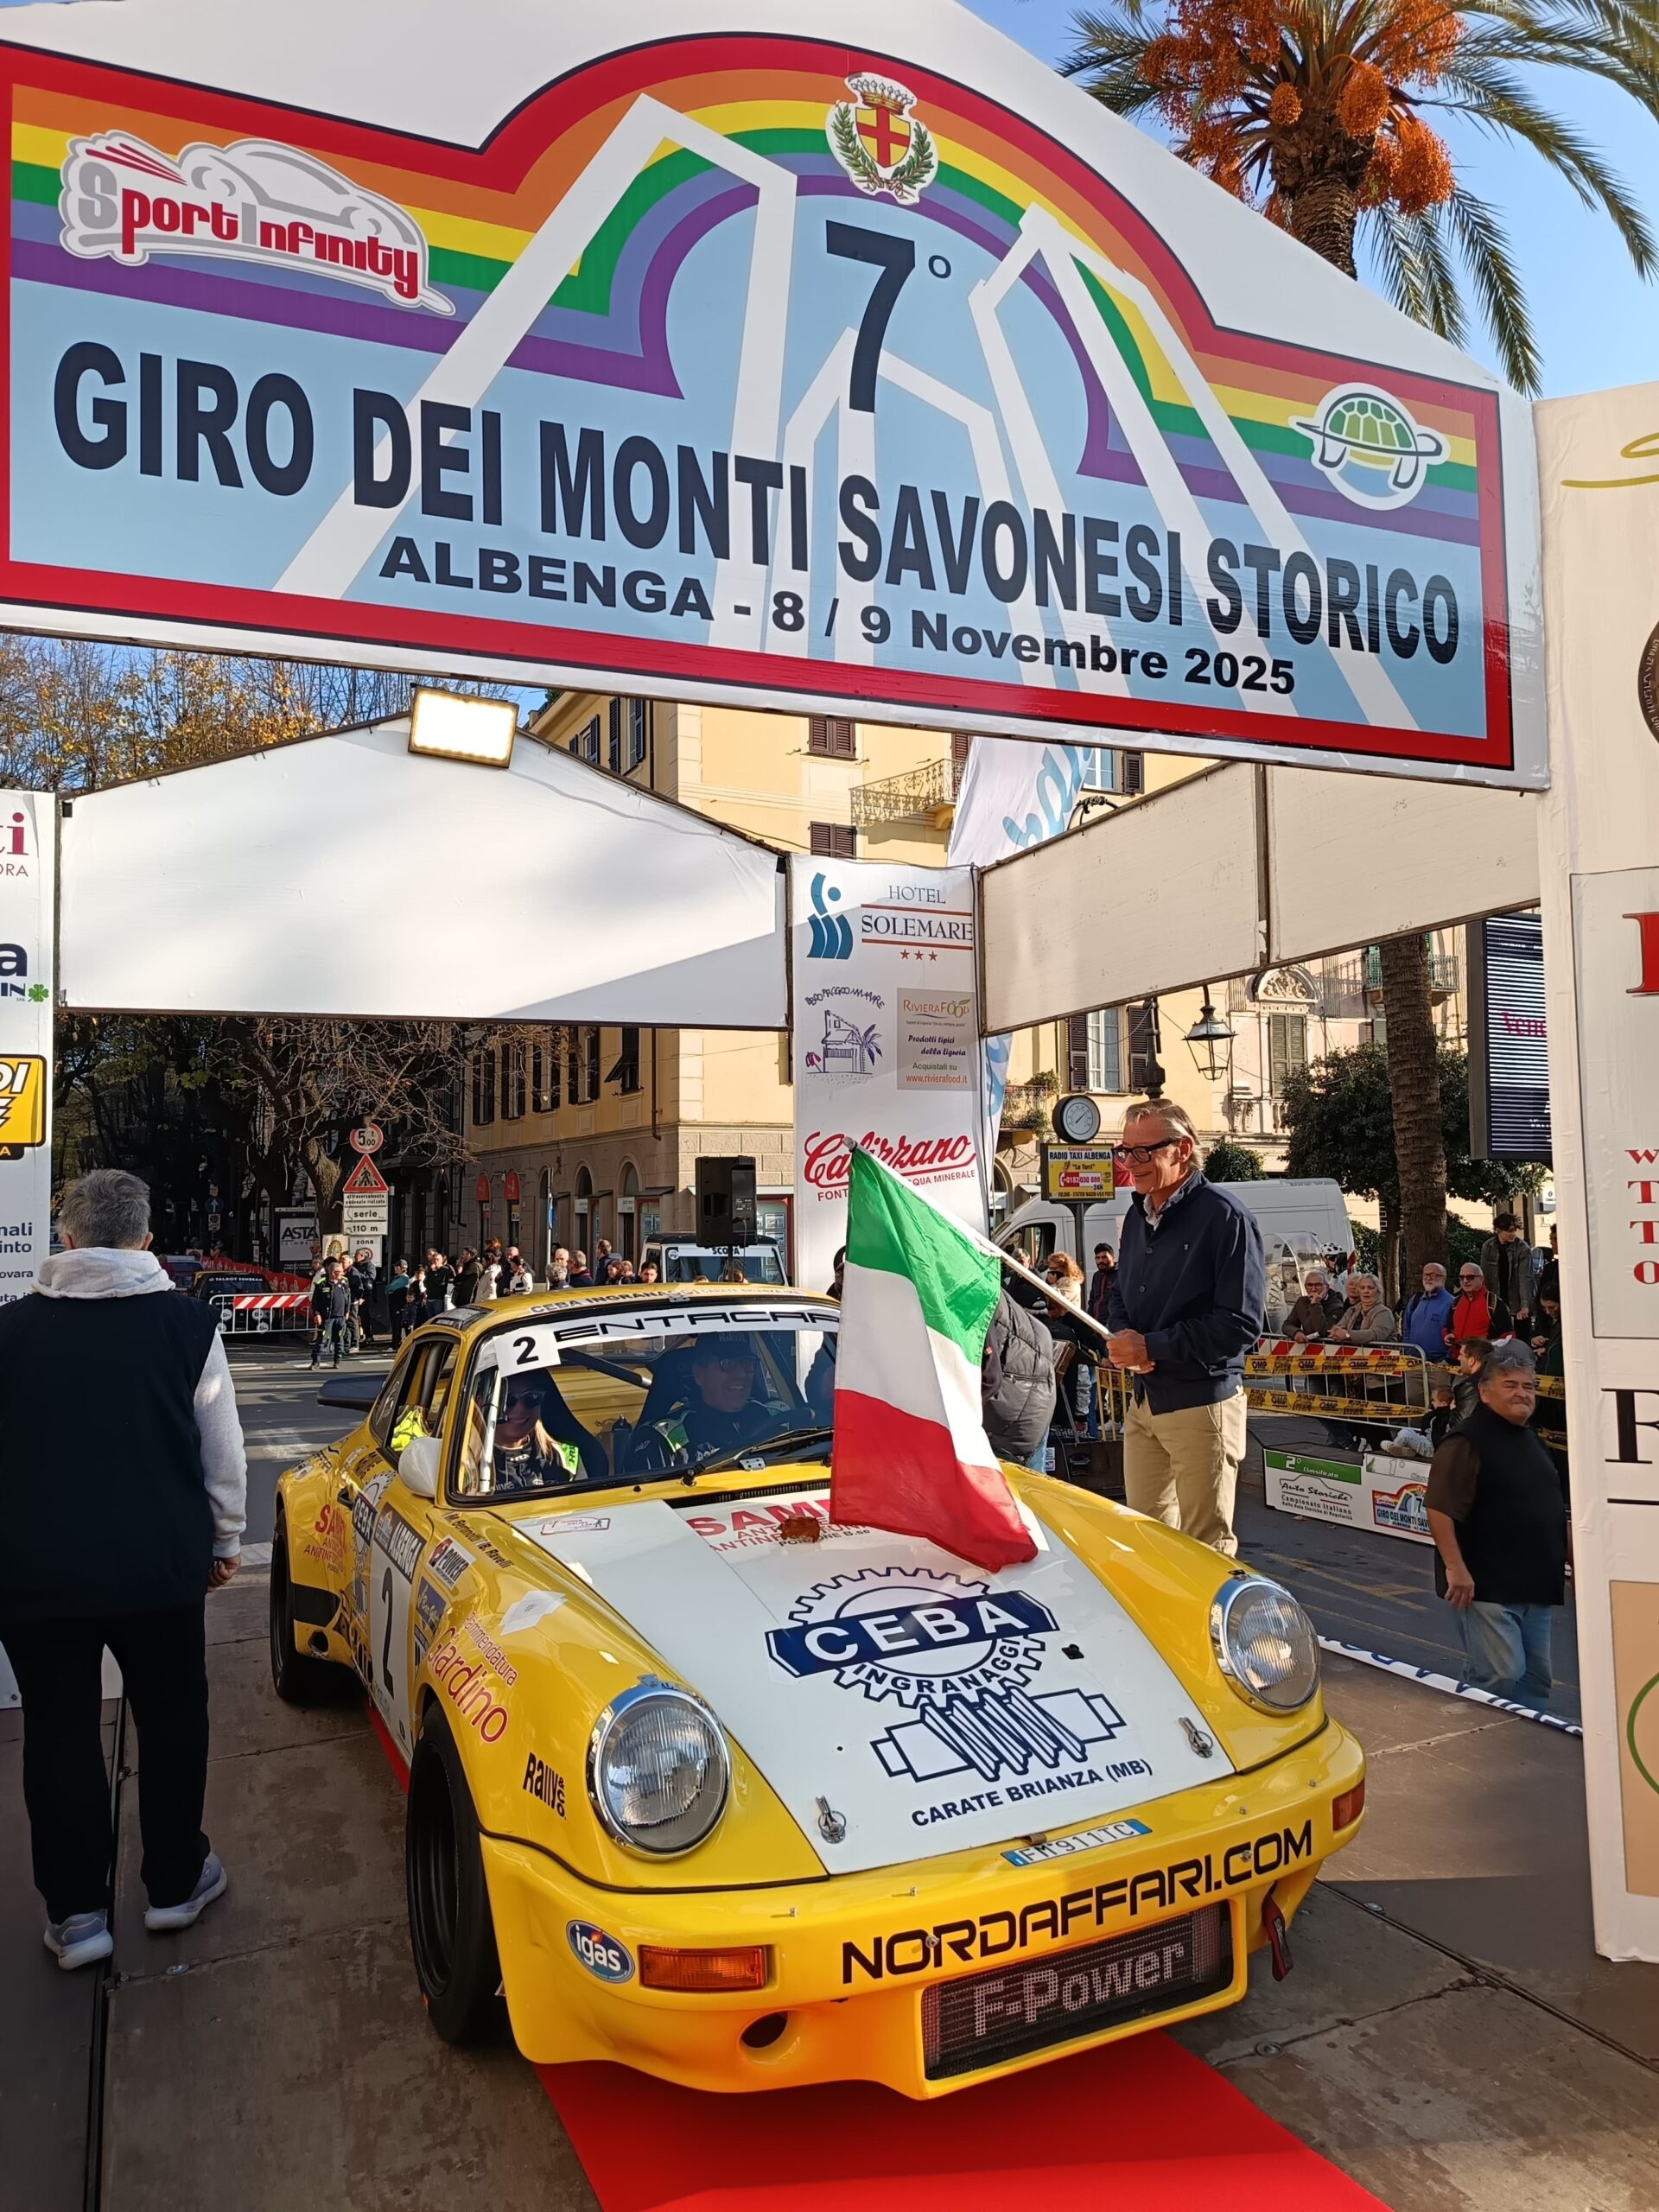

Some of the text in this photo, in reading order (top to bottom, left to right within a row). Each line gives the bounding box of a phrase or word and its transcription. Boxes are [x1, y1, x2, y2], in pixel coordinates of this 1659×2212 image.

[54, 341, 1459, 664] GIRO DEI MONTI SAVONESI STORICO
[379, 537, 715, 620] ALBENGA
[772, 590, 805, 632] 8
[861, 604, 892, 645] 9
[912, 611, 1169, 680] Novembre
[1185, 647, 1297, 696] 2025
[889, 885, 946, 904] HOTEL
[861, 914, 973, 941] SOLEMARE
[906, 1074, 967, 1084] www.rivierafood.it
[817, 1170, 976, 1202] FONT QUA MINERALE
[282, 1226, 319, 1240] ASTA
[531, 1300, 582, 1313] CEBA
[512, 1336, 539, 1366] 2
[1252, 1361, 1268, 1370] OMP
[1281, 1482, 1349, 1501] Auto Storiche
[1281, 1495, 1351, 1516] Campionato Italiano
[353, 1497, 373, 1541] CEBA
[1376, 1509, 1389, 1519] GIRO
[1390, 1511, 1399, 1521] DEI
[1400, 1513, 1416, 1525] MONTI
[438, 1548, 470, 1582] POWER
[382, 1567, 394, 1700] 2
[804, 1601, 1026, 1663] CEBA
[427, 1627, 508, 1743] Giardino
[852, 1637, 1021, 1695] INGRANAGGI
[522, 1751, 557, 1809] Rally
[912, 1758, 1154, 1827] CARATE BRIANZA (MB)
[842, 1820, 1313, 1985] NORDAFFARI.COM
[575, 1924, 621, 1972] igas
[974, 1941, 1185, 2037] F-Power
